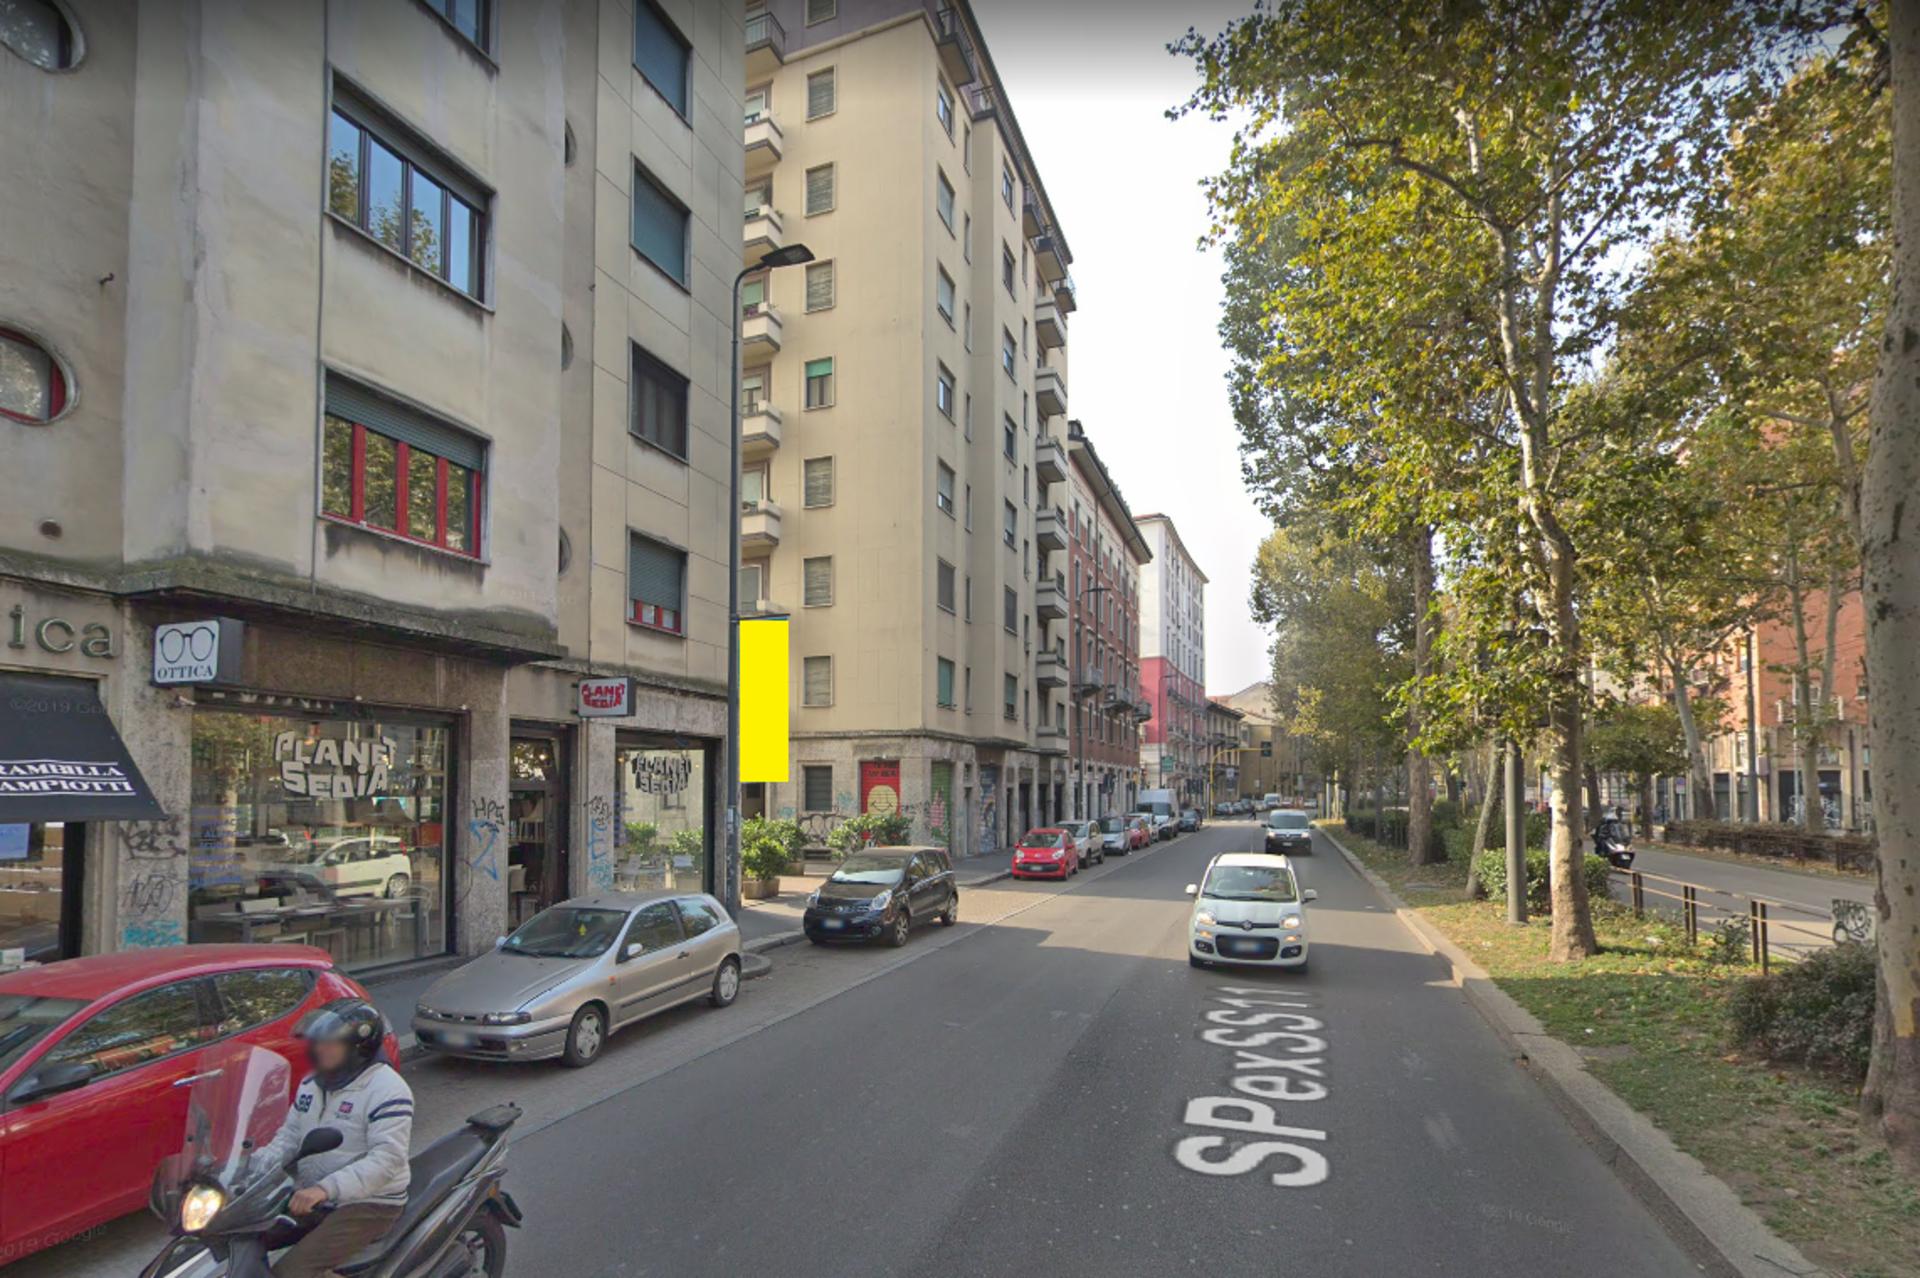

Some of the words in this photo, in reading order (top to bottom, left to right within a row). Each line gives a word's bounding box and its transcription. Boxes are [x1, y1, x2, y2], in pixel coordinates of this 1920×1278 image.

[8, 604, 121, 659] ica
[157, 664, 214, 680] OTTICA
[275, 731, 397, 767] PLANET
